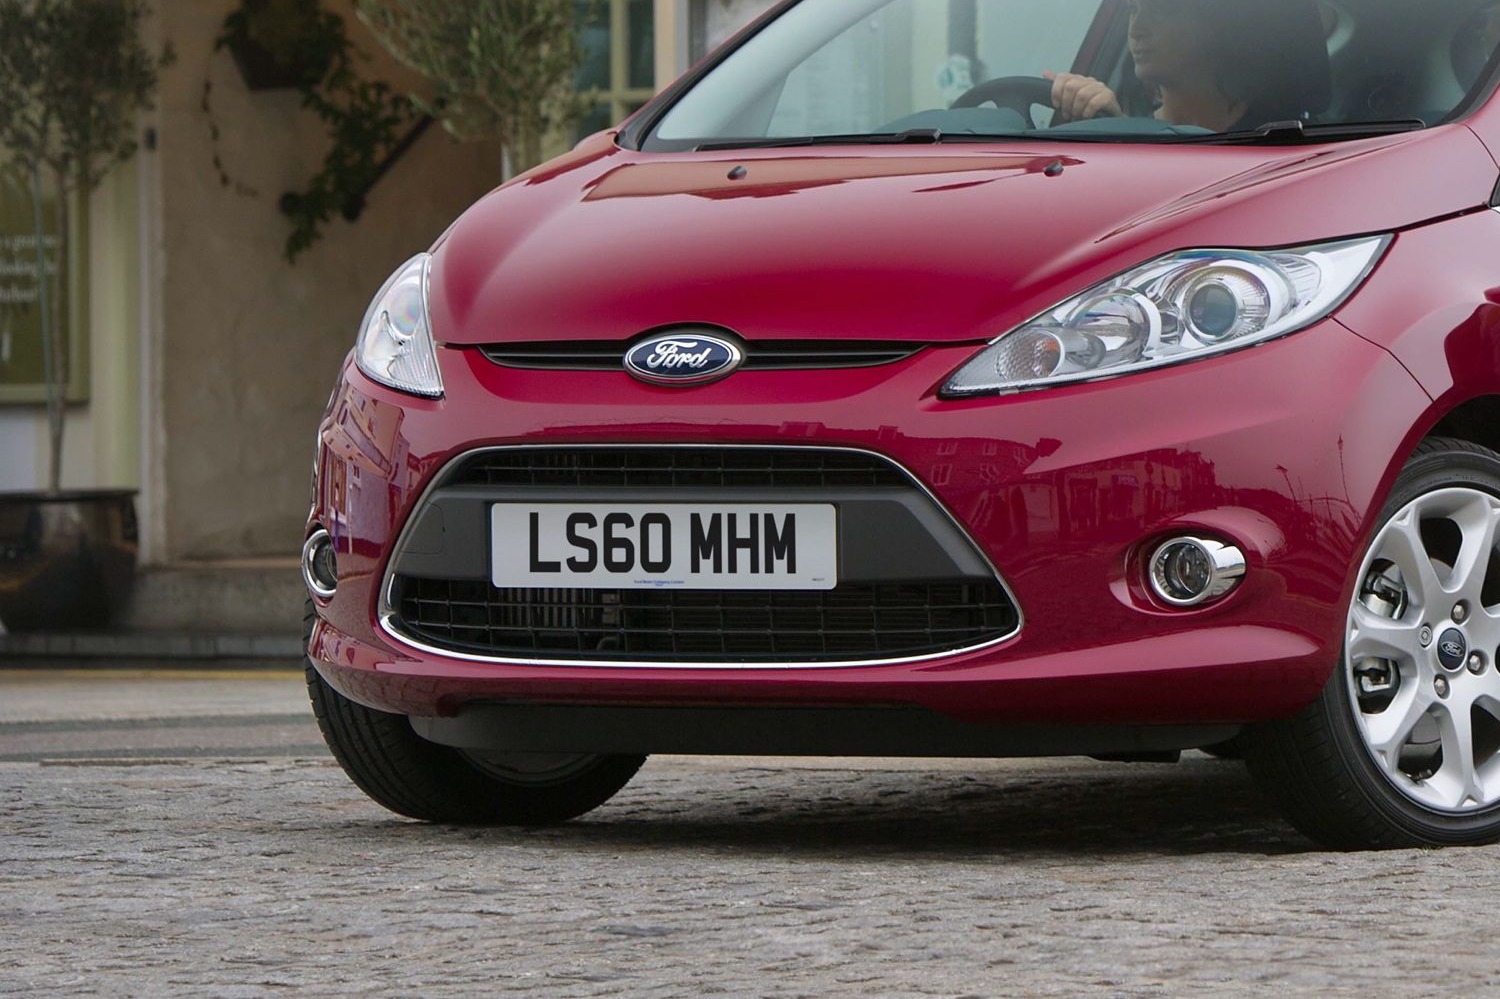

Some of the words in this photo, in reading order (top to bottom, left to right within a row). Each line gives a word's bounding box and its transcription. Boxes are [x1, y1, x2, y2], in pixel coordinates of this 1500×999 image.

[646, 341, 712, 369] Ford
[529, 512, 672, 574] LS60
[690, 513, 797, 574] MHM
